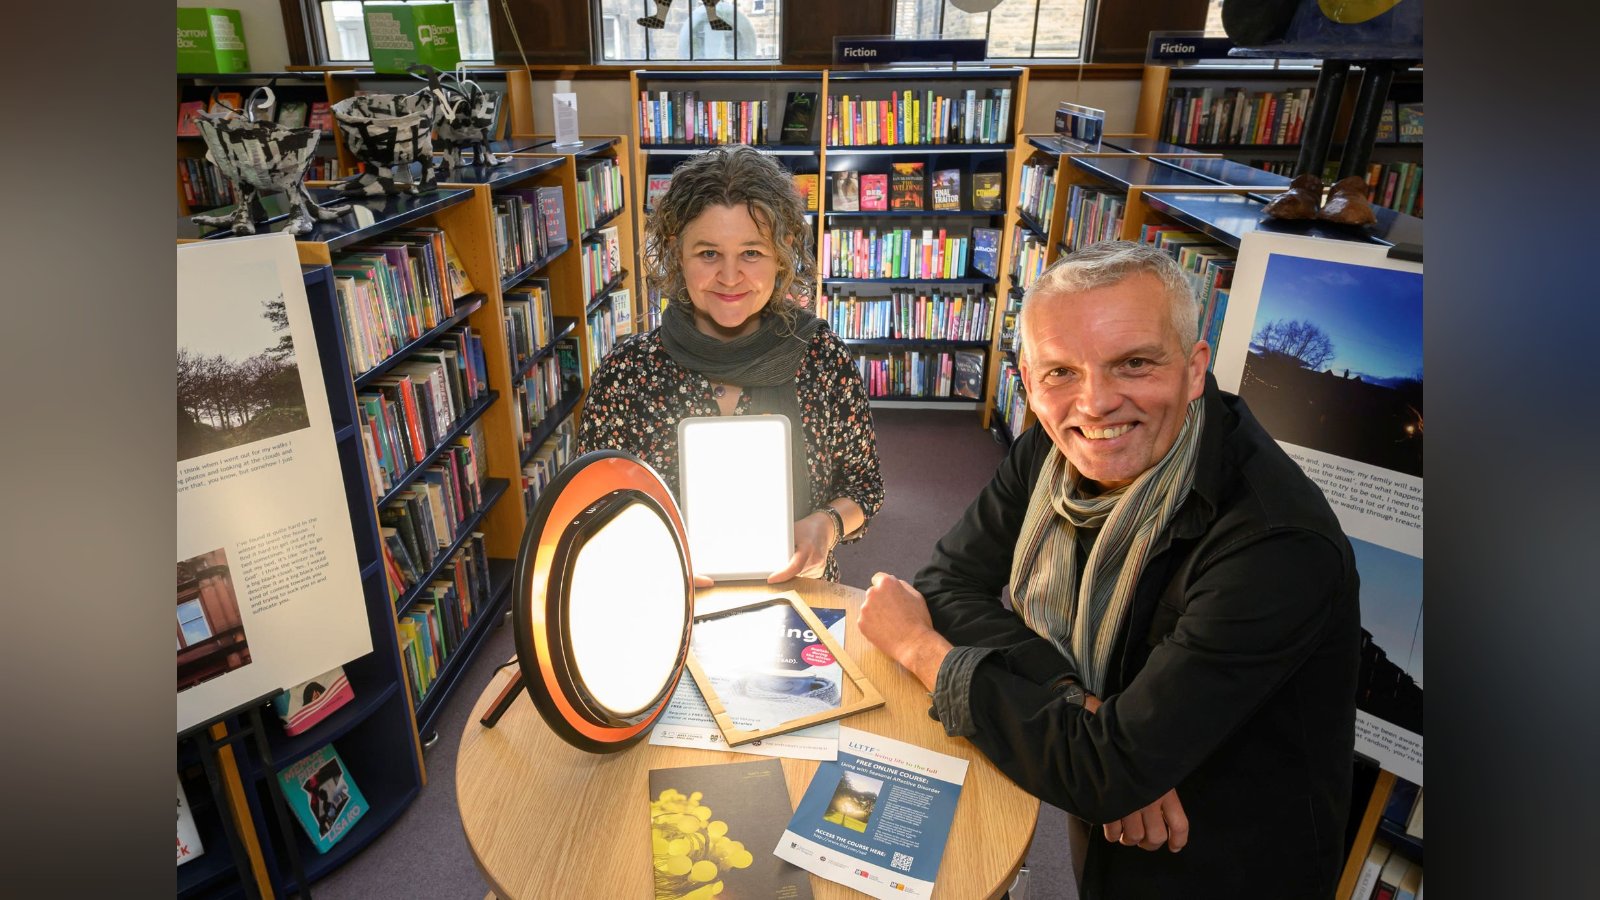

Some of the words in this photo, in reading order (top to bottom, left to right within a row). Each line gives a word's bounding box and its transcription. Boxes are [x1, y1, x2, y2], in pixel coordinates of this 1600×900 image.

[844, 48, 877, 56] Fiction
[1160, 43, 1196, 53] Fiction
[935, 189, 949, 197] FINAL
[936, 195, 958, 203] TRAITOR
[184, 466, 200, 474] think
[223, 455, 238, 463] went
[272, 442, 288, 450] walks
[185, 474, 206, 483] photos
[207, 468, 219, 476] and
[220, 463, 242, 472] looking
[262, 452, 280, 460] clouds
[250, 461, 277, 472] somehow
[1307, 466, 1320, 474] just
[1322, 470, 1333, 478] the
[1360, 481, 1373, 489] and
[1375, 485, 1392, 494] what
[1322, 462, 1335, 470] you
[1370, 474, 1393, 486] family
[1409, 486, 1421, 494] say
[1338, 484, 1349, 492] try
[1392, 499, 1410, 508] need
[1340, 502, 1365, 514] wading
[1366, 509, 1393, 521] through
[1396, 518, 1423, 529] treacle.
[1366, 499, 1375, 507] lot
[1400, 510, 1421, 520] about
[247, 584, 271, 595] describe
[299, 568, 314, 576] black
[290, 576, 312, 586] towards
[252, 603, 277, 615] suffocate
[262, 595, 279, 604] trying
[779, 624, 818, 642] ing
[1364, 737, 1391, 752] random,
[1381, 728, 1397, 738] been
[1399, 736, 1420, 748] aware
[1382, 736, 1393, 744] the
[1394, 742, 1409, 751] year
[856, 759, 872, 767] FREE
[873, 764, 898, 775] ONLINE
[899, 772, 929, 784] COURSE:
[869, 770, 892, 780] Seasonal
[892, 777, 916, 787] Affective
[917, 784, 940, 794] Disorder
[328, 819, 348, 842] LISA
[346, 805, 360, 824] KO
[816, 828, 835, 839] ACCESS
[847, 840, 869, 851] COURSE
[870, 848, 886, 856] HERE:
